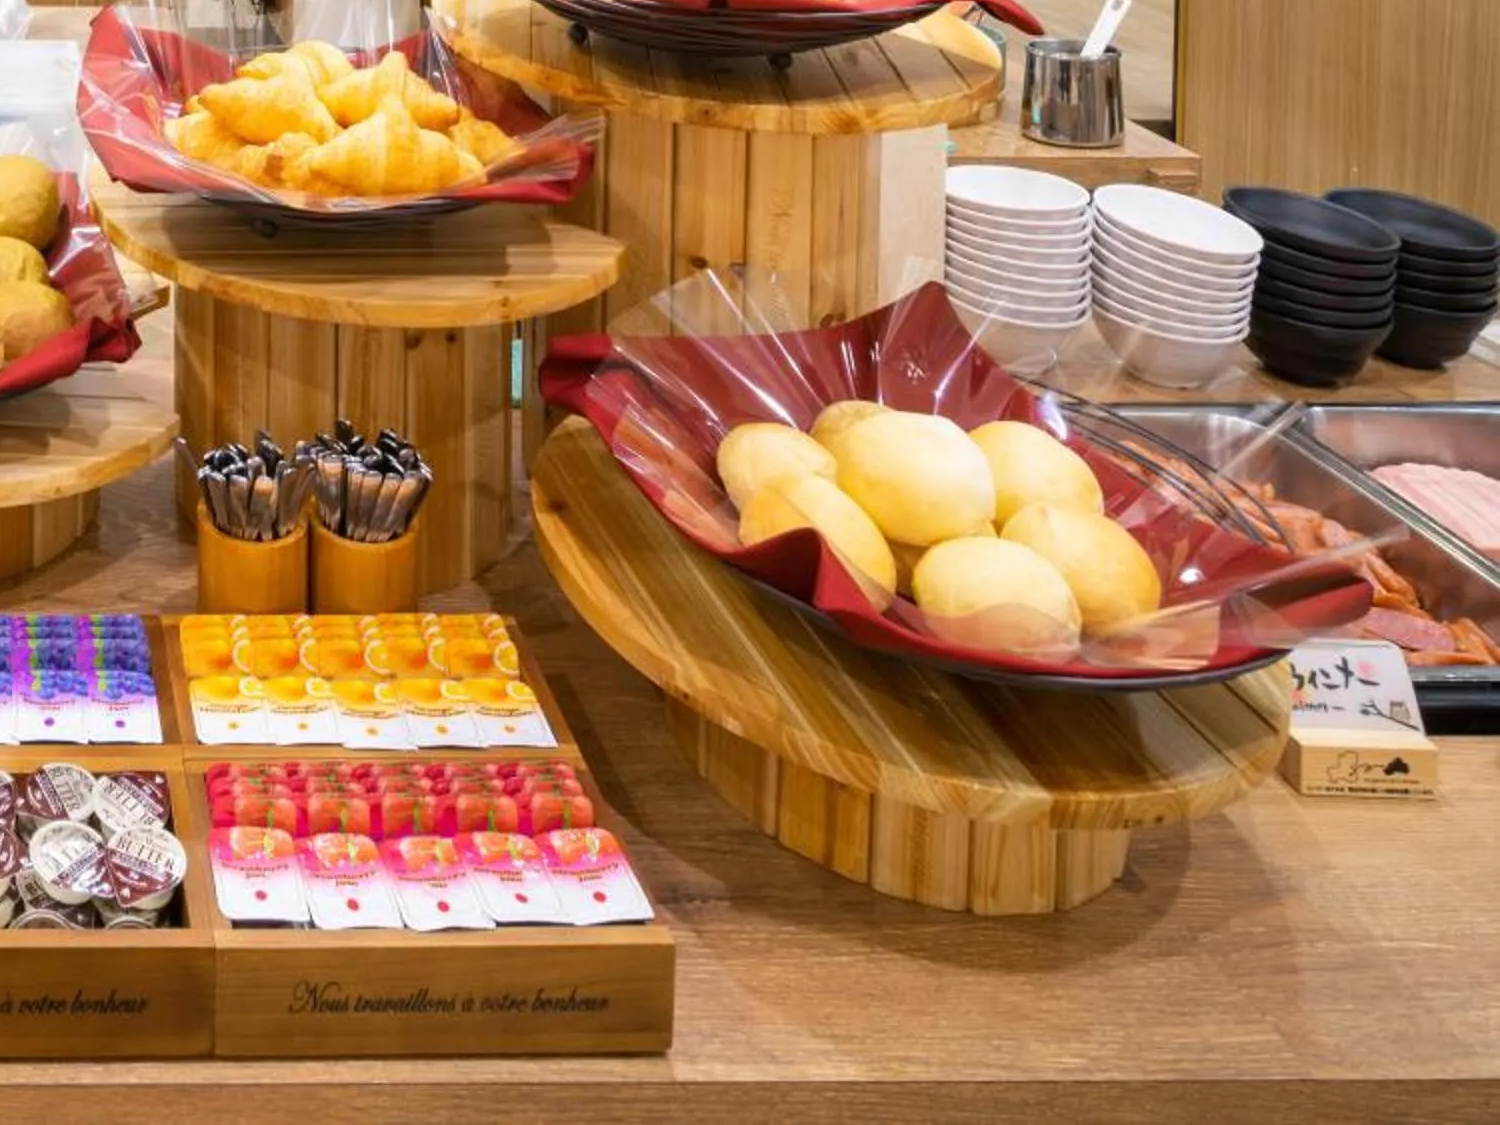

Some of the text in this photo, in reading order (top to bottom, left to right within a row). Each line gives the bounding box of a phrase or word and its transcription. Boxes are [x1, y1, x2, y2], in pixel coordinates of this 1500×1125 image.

[117, 835, 174, 872] BUTTER
[0, 993, 12, 1015] à
[17, 994, 67, 1015] votre
[70, 988, 148, 1016] bonheur
[289, 980, 608, 1014] Nous travaillons à votre bonheur
